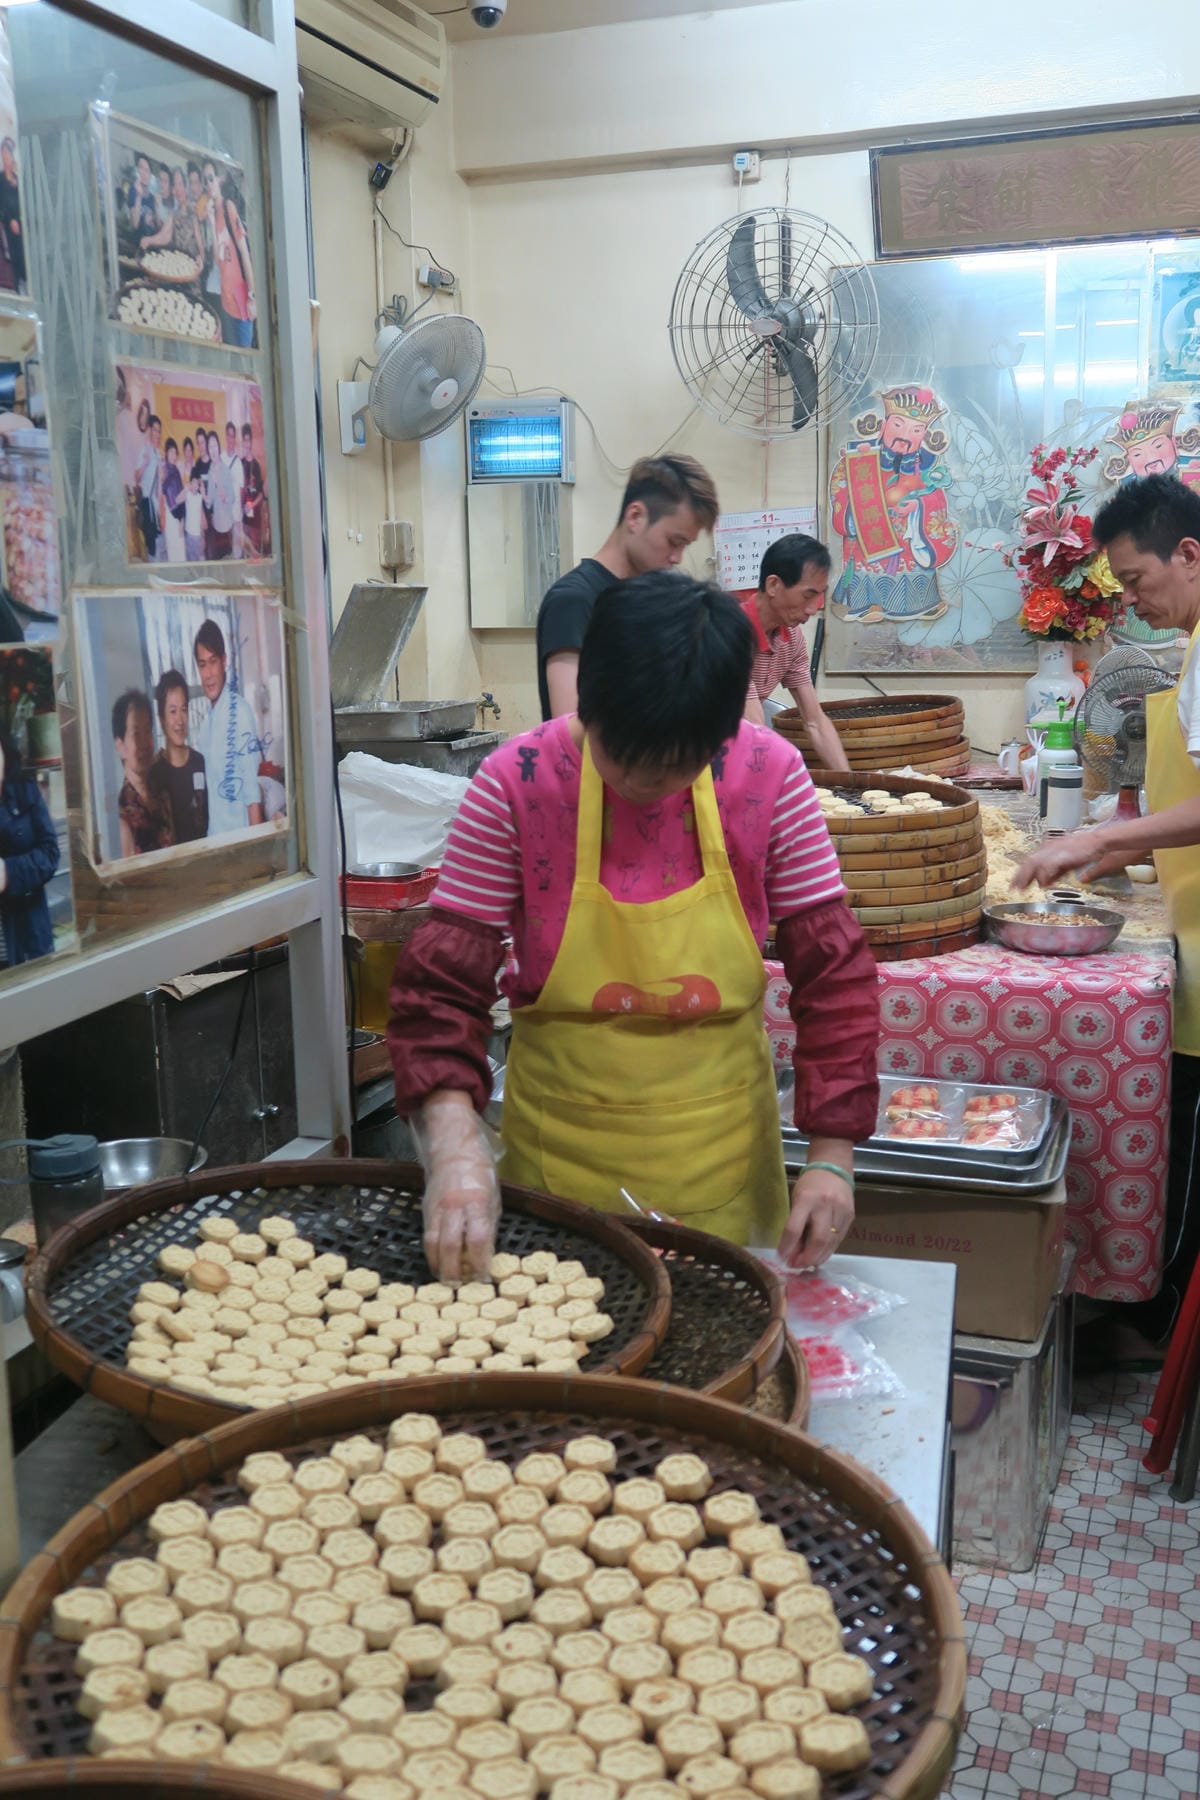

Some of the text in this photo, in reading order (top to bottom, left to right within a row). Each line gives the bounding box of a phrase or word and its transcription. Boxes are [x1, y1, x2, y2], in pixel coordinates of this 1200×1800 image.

[761, 513, 774, 523] 11
[848, 1226, 972, 1254] Almond 20/22
